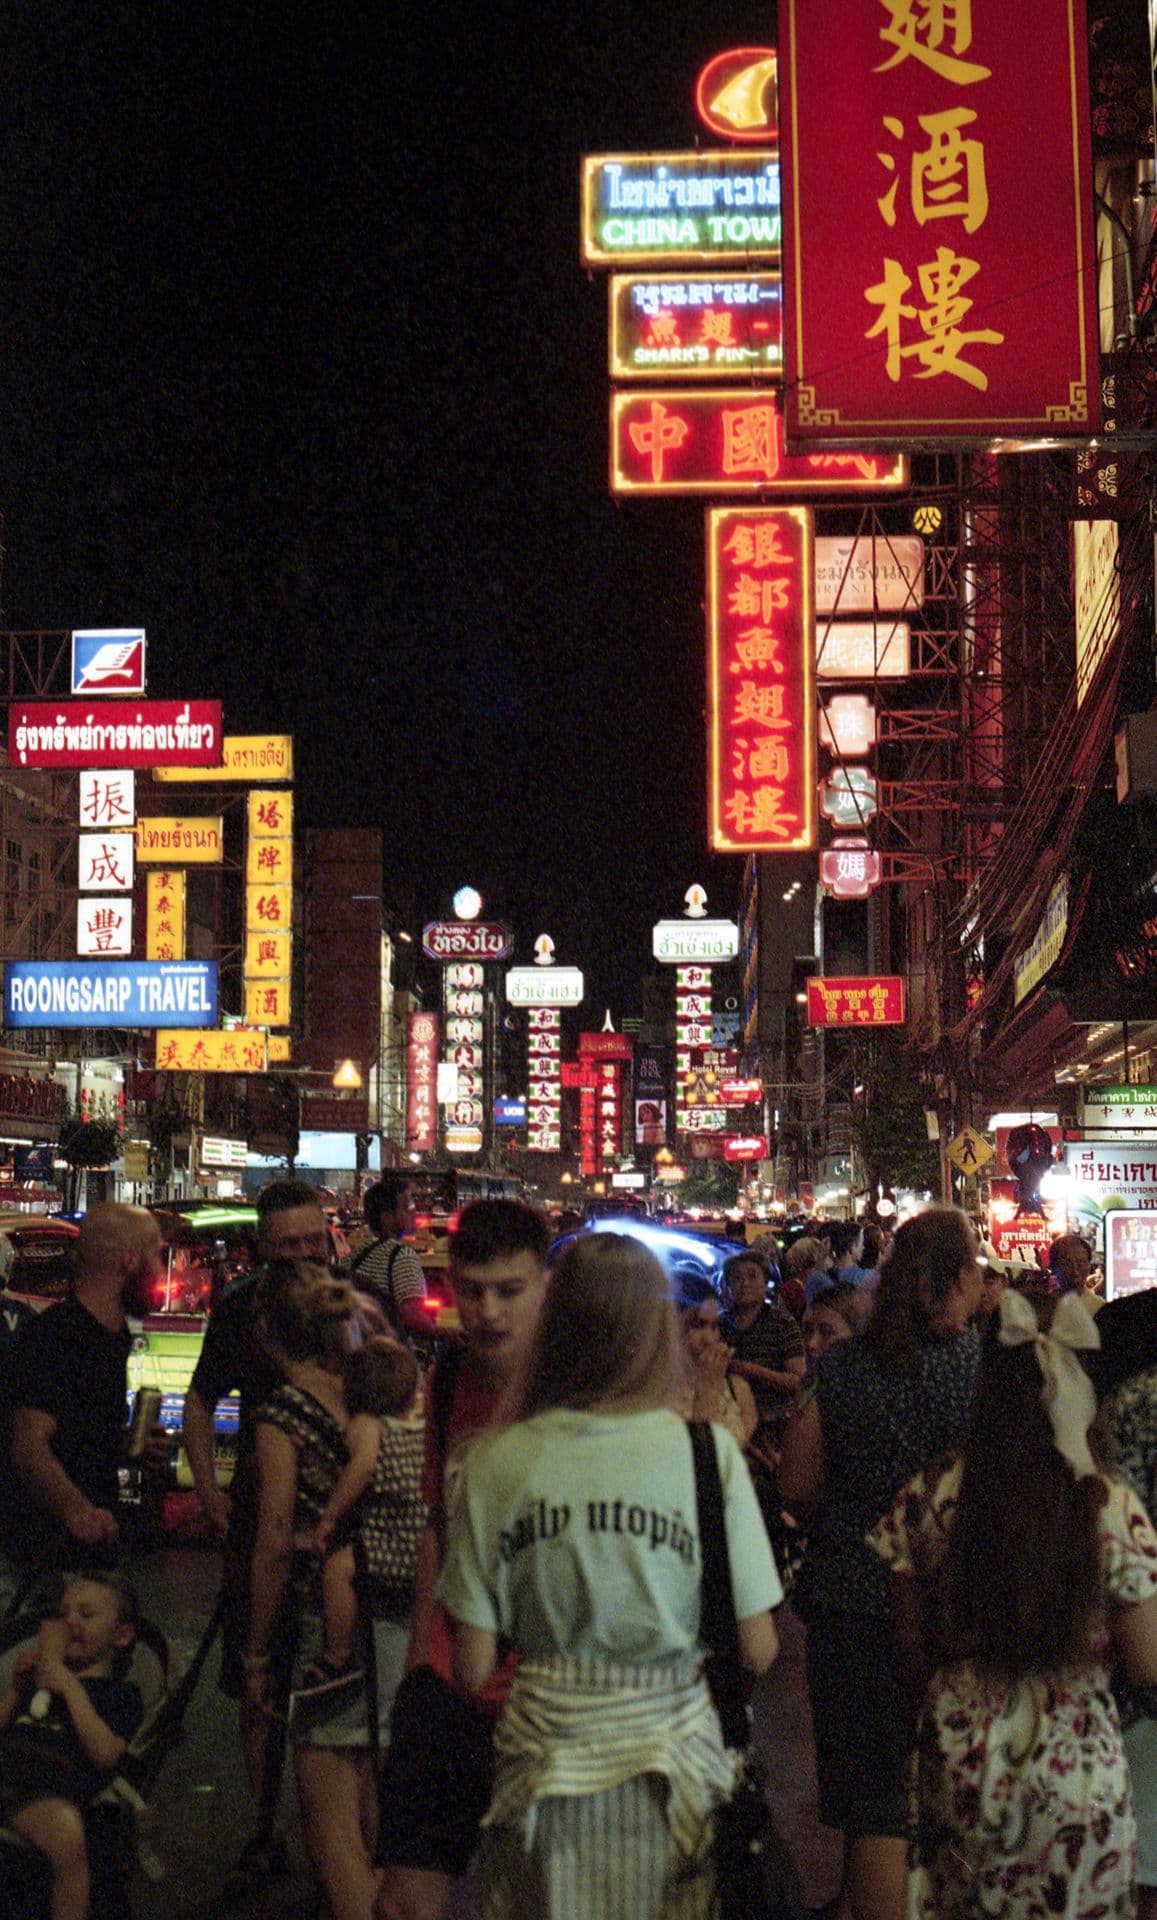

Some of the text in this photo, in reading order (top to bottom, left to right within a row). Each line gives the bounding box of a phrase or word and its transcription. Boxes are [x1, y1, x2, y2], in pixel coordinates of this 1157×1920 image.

[602, 218, 700, 244] CHINA
[633, 346, 709, 363] SHARK'S
[722, 521, 799, 838] 銀都魚翅酒樓
[15, 704, 214, 764] รุ่งทรัพย์การท่องเที่ยว
[84, 778, 131, 953] 振成豐
[10, 976, 211, 1012] ROONGSARP TRAVEL
[587, 1498, 698, 1566] utopia
